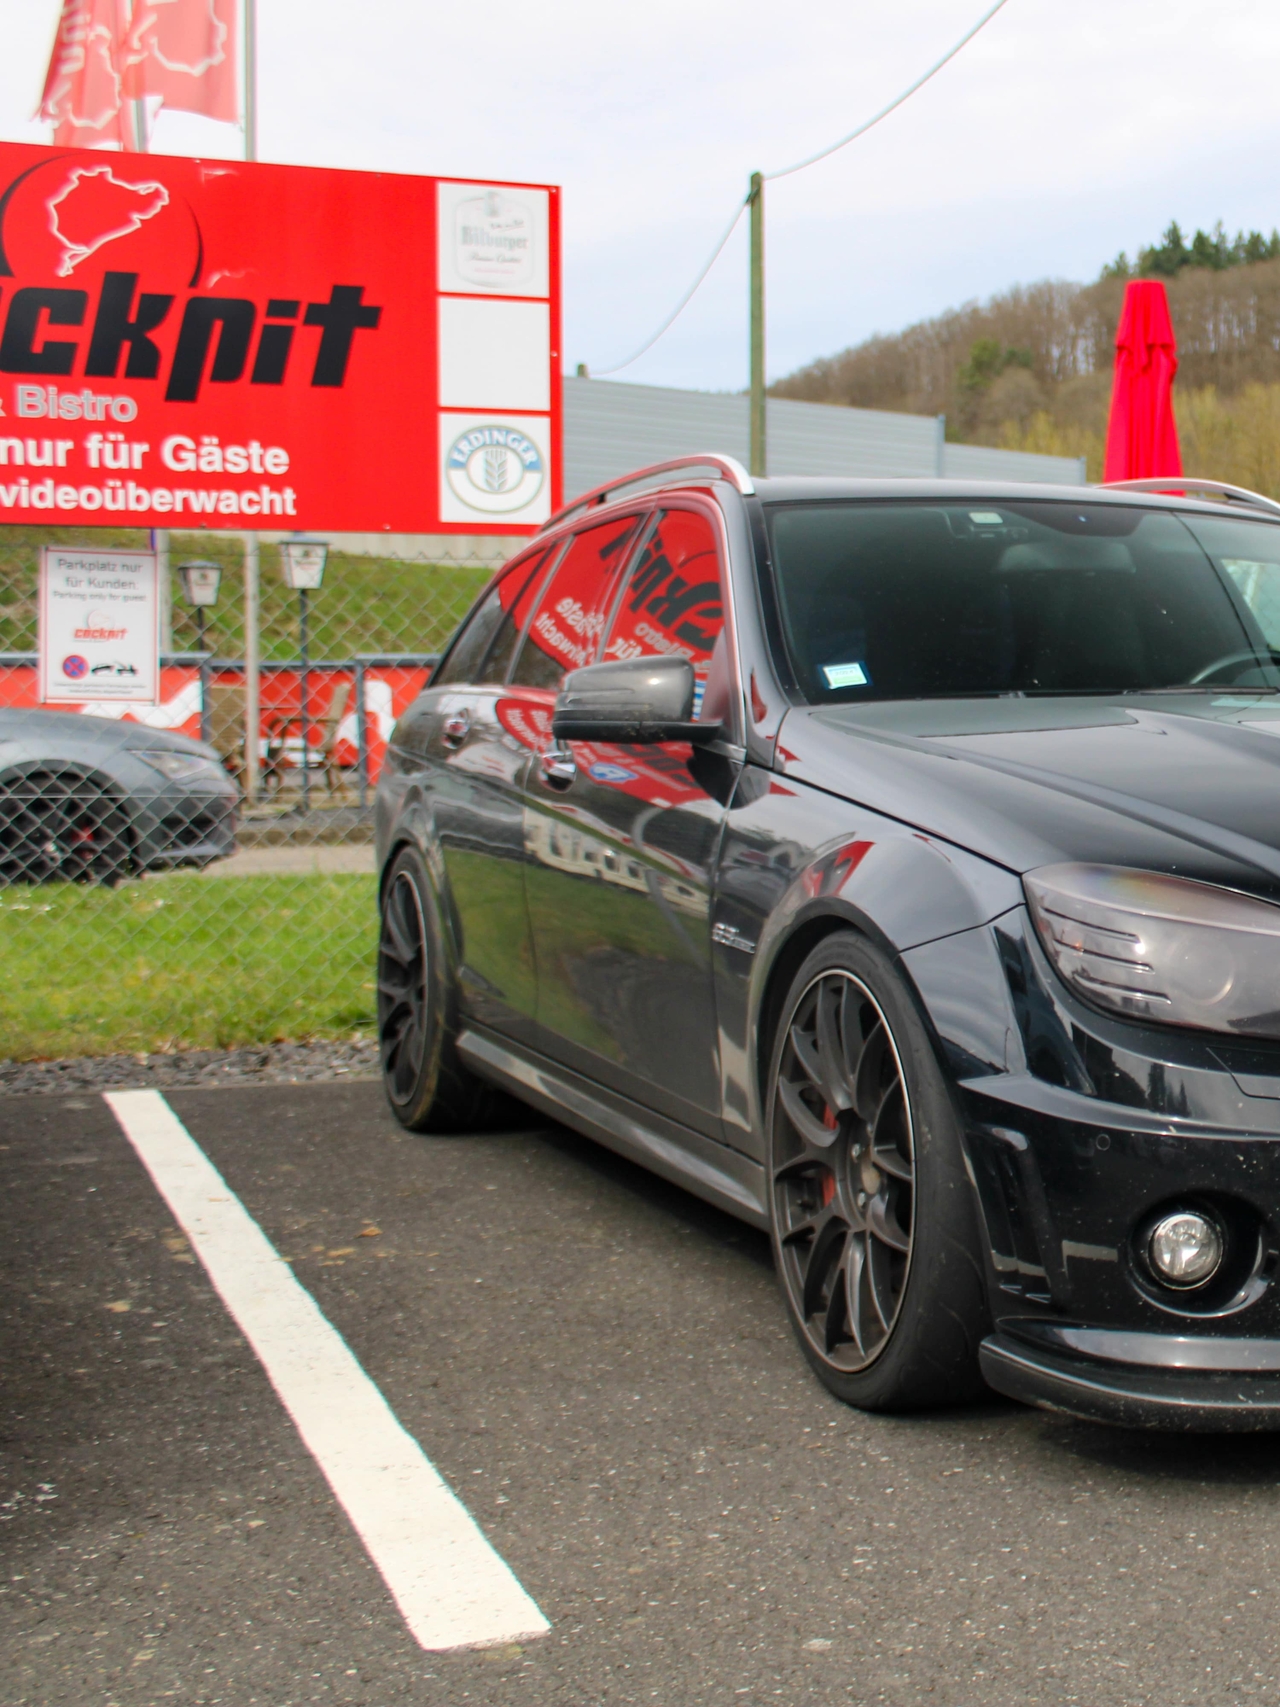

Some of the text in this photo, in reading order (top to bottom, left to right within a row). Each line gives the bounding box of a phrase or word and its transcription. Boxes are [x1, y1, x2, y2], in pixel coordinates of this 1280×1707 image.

[0, 271, 383, 402] ckpit
[17, 385, 138, 422] Bistro
[0, 432, 291, 475] nur für Gäste
[452, 429, 538, 466] ERDINGER
[0, 477, 297, 516] videoüberwacht
[57, 558, 144, 573] Parkplatz nur
[65, 576, 84, 588] für
[74, 627, 129, 641] cockpit
